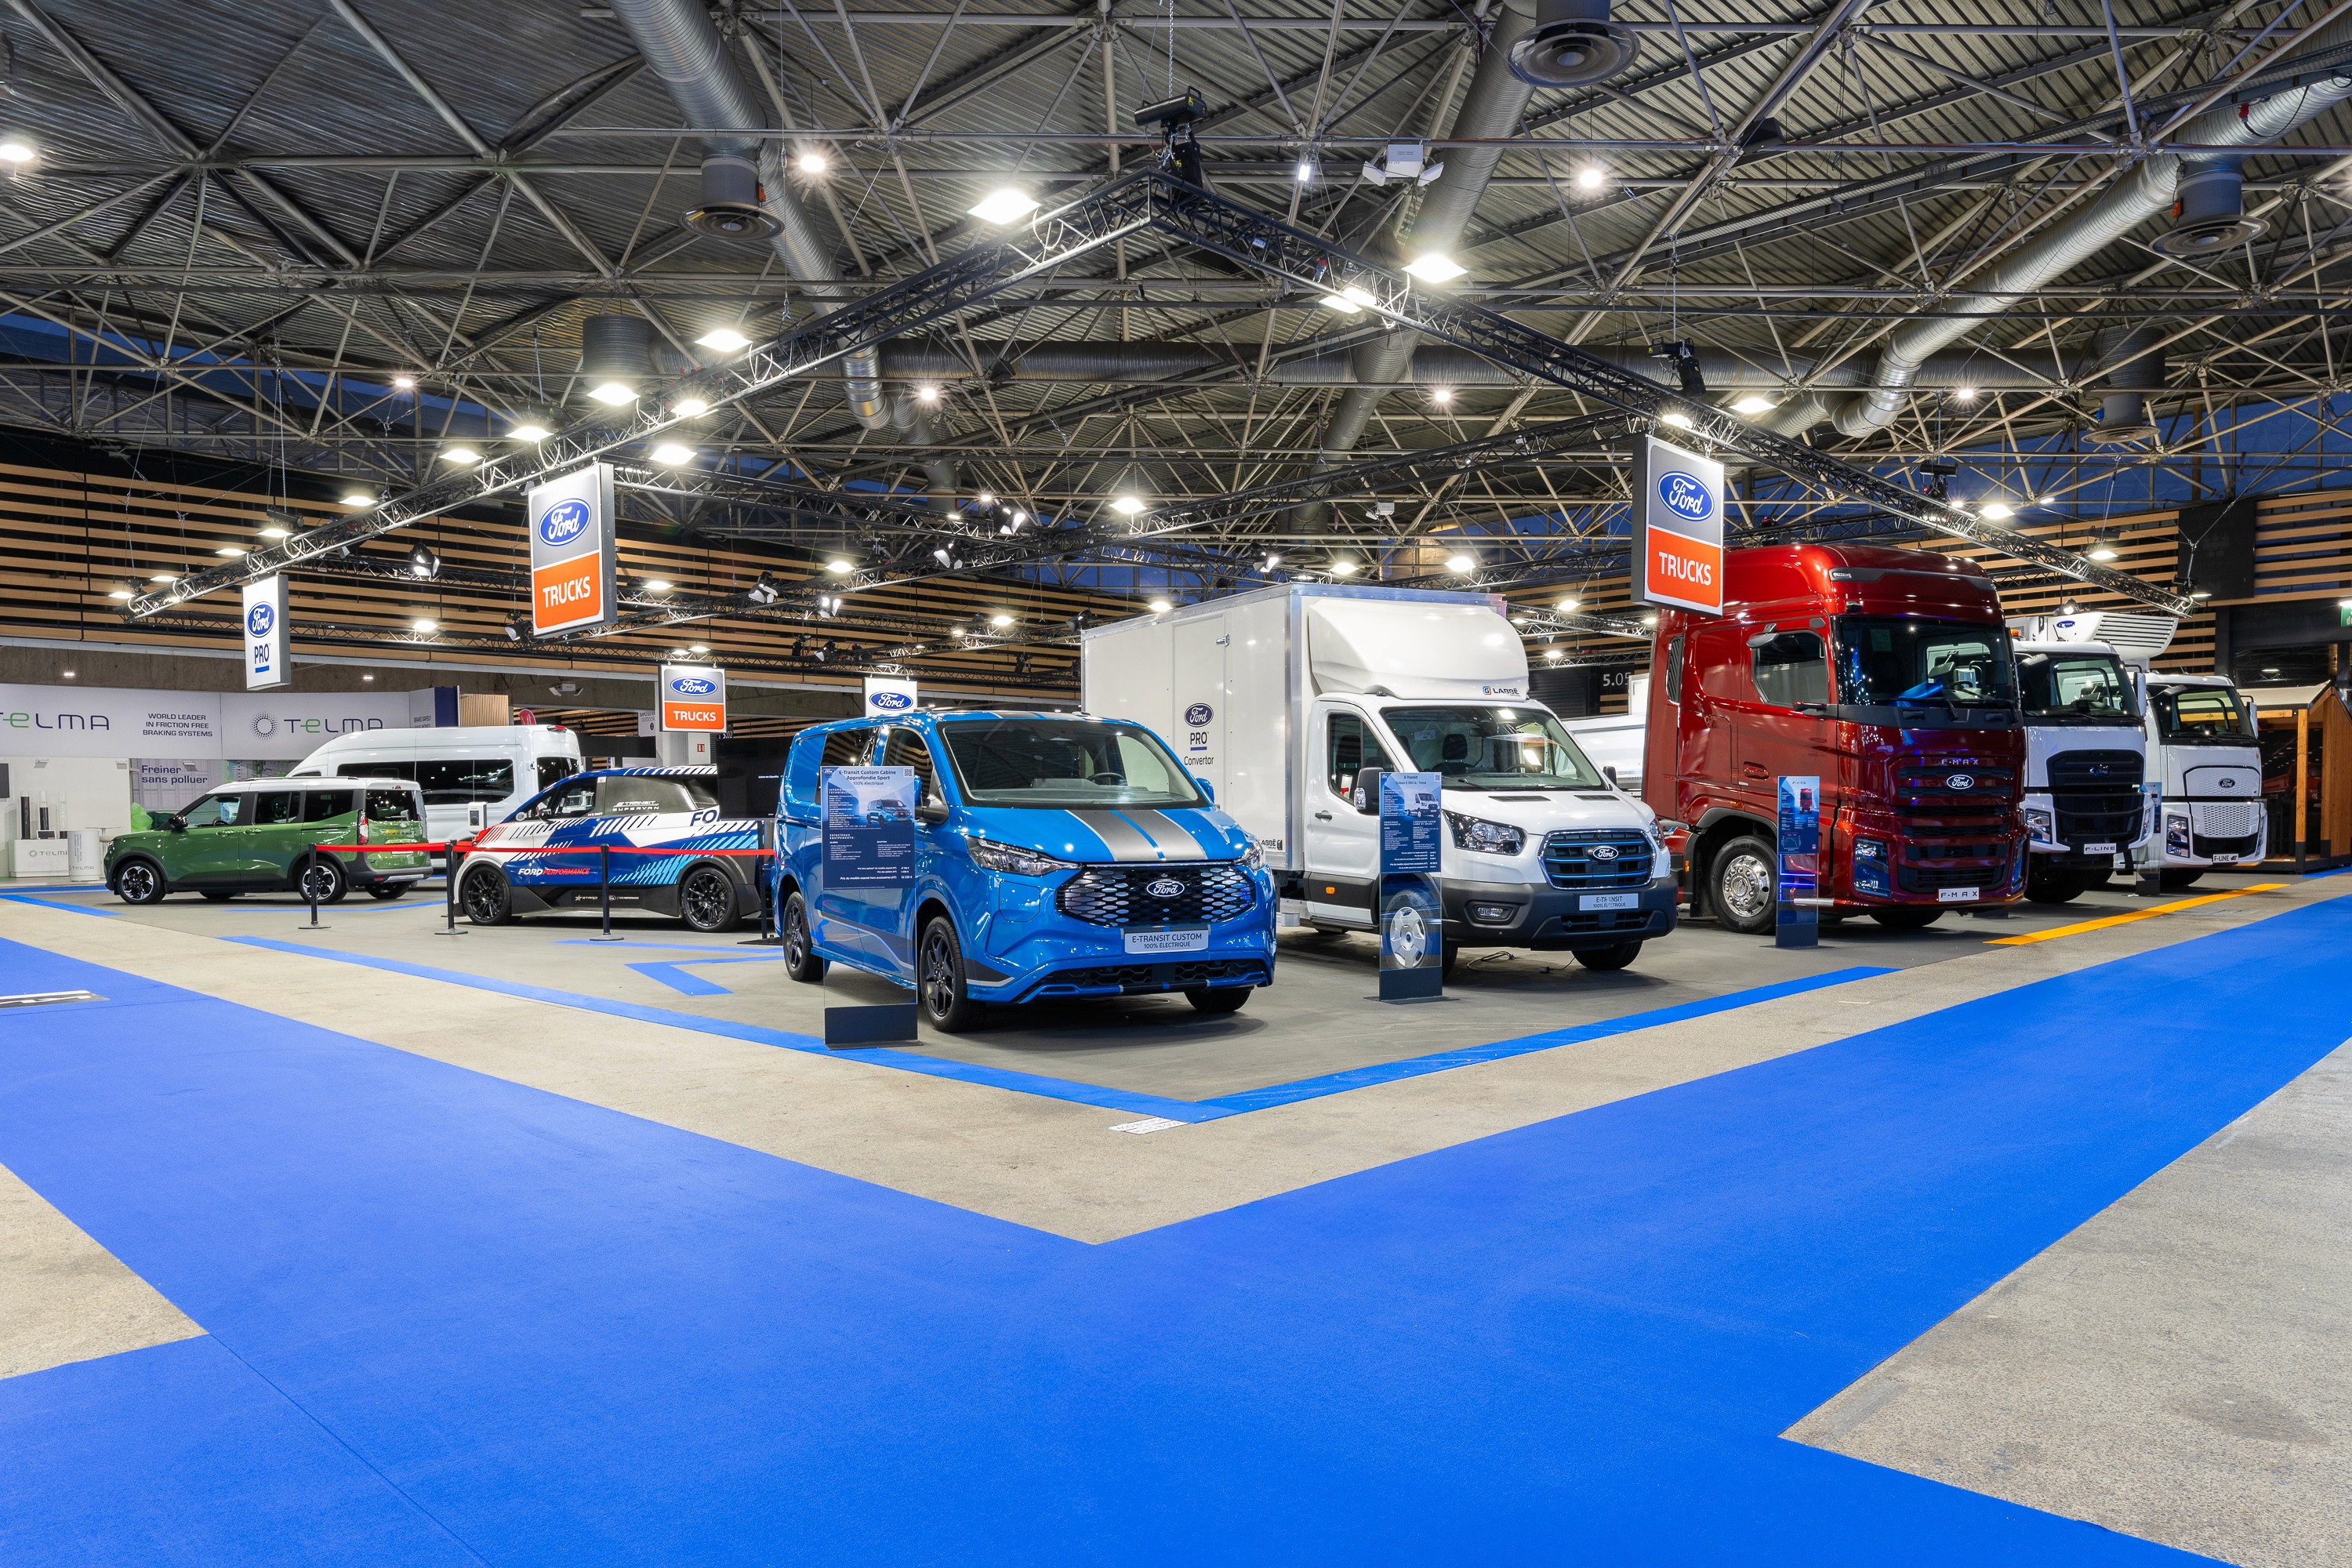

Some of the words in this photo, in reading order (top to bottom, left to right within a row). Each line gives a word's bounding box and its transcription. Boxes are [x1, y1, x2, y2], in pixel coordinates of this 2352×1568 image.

[1668, 477, 1704, 515] Ford
[548, 506, 581, 540] Ford
[1658, 551, 1711, 586] TRUCKS
[543, 575, 591, 608] TRUCKS
[252, 607, 270, 632] Ford
[254, 643, 270, 664] PRO
[679, 679, 708, 693] Ford
[878, 693, 905, 707] Ford
[673, 710, 717, 721] TRUCKS
[1189, 707, 1208, 723] Ford
[1190, 731, 1207, 745] PRO
[1184, 756, 1214, 765] Convertor
[141, 764, 182, 774] Freiner
[171, 775, 208, 786] polluer
[1951, 776, 1969, 787] Ford
[690, 810, 720, 826] FO
[1598, 849, 1614, 858] Ford
[517, 868, 543, 877] FORD
[1153, 882, 1178, 894] Ford
[1132, 934, 1170, 942] E-TRANSIT
